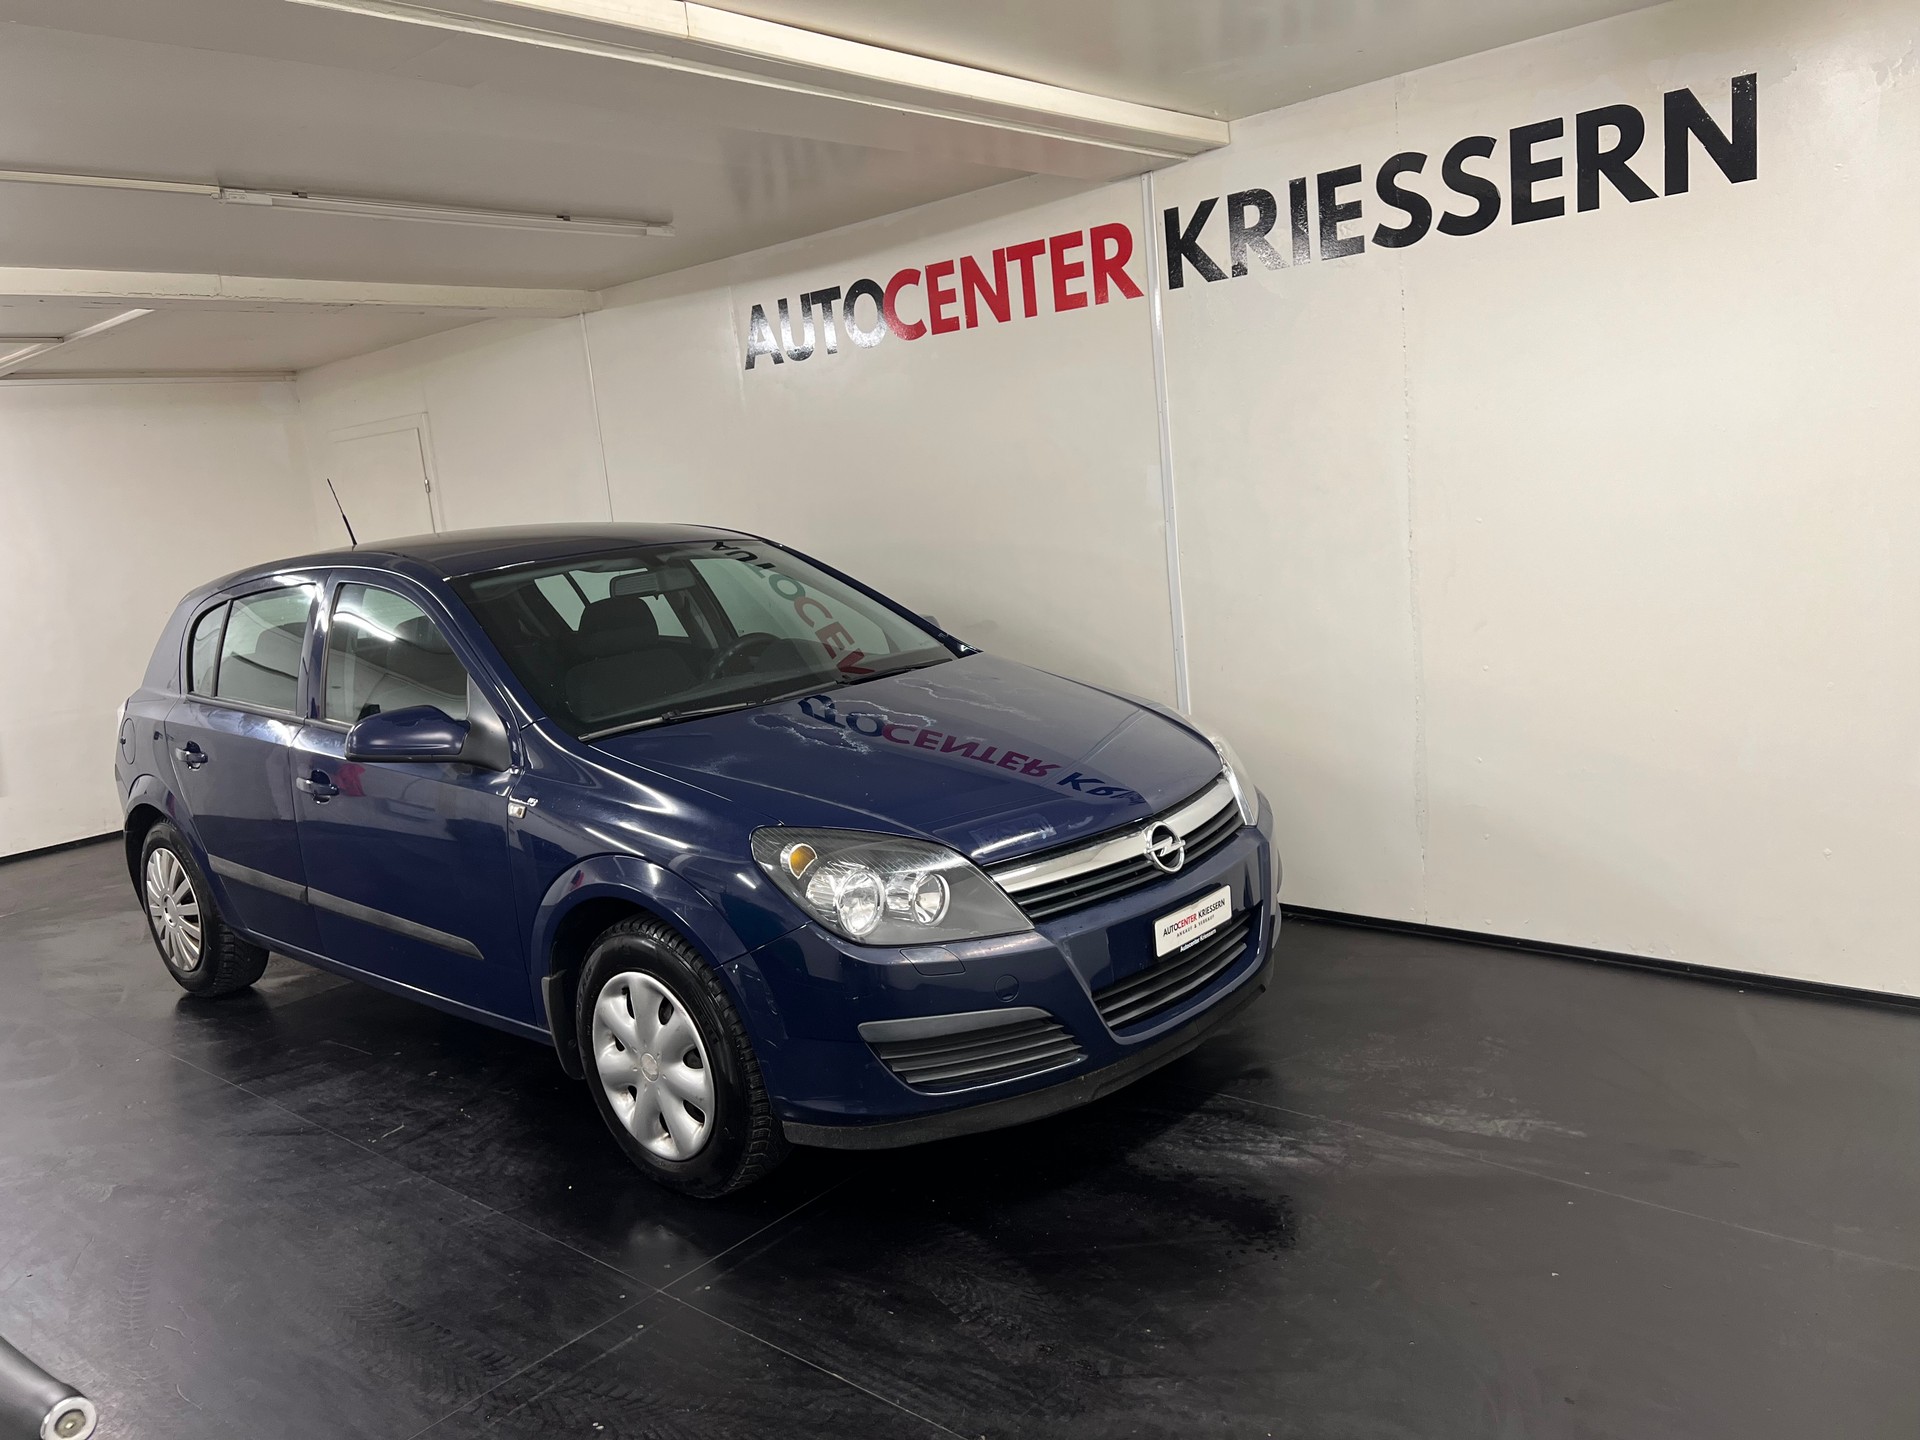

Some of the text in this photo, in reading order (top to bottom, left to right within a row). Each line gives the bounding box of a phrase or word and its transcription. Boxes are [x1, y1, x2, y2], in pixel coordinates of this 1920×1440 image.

[745, 73, 1757, 370] AUTOCENTER KRIESSERN
[1163, 898, 1225, 937] AUTOCENTER KRIESSERN
